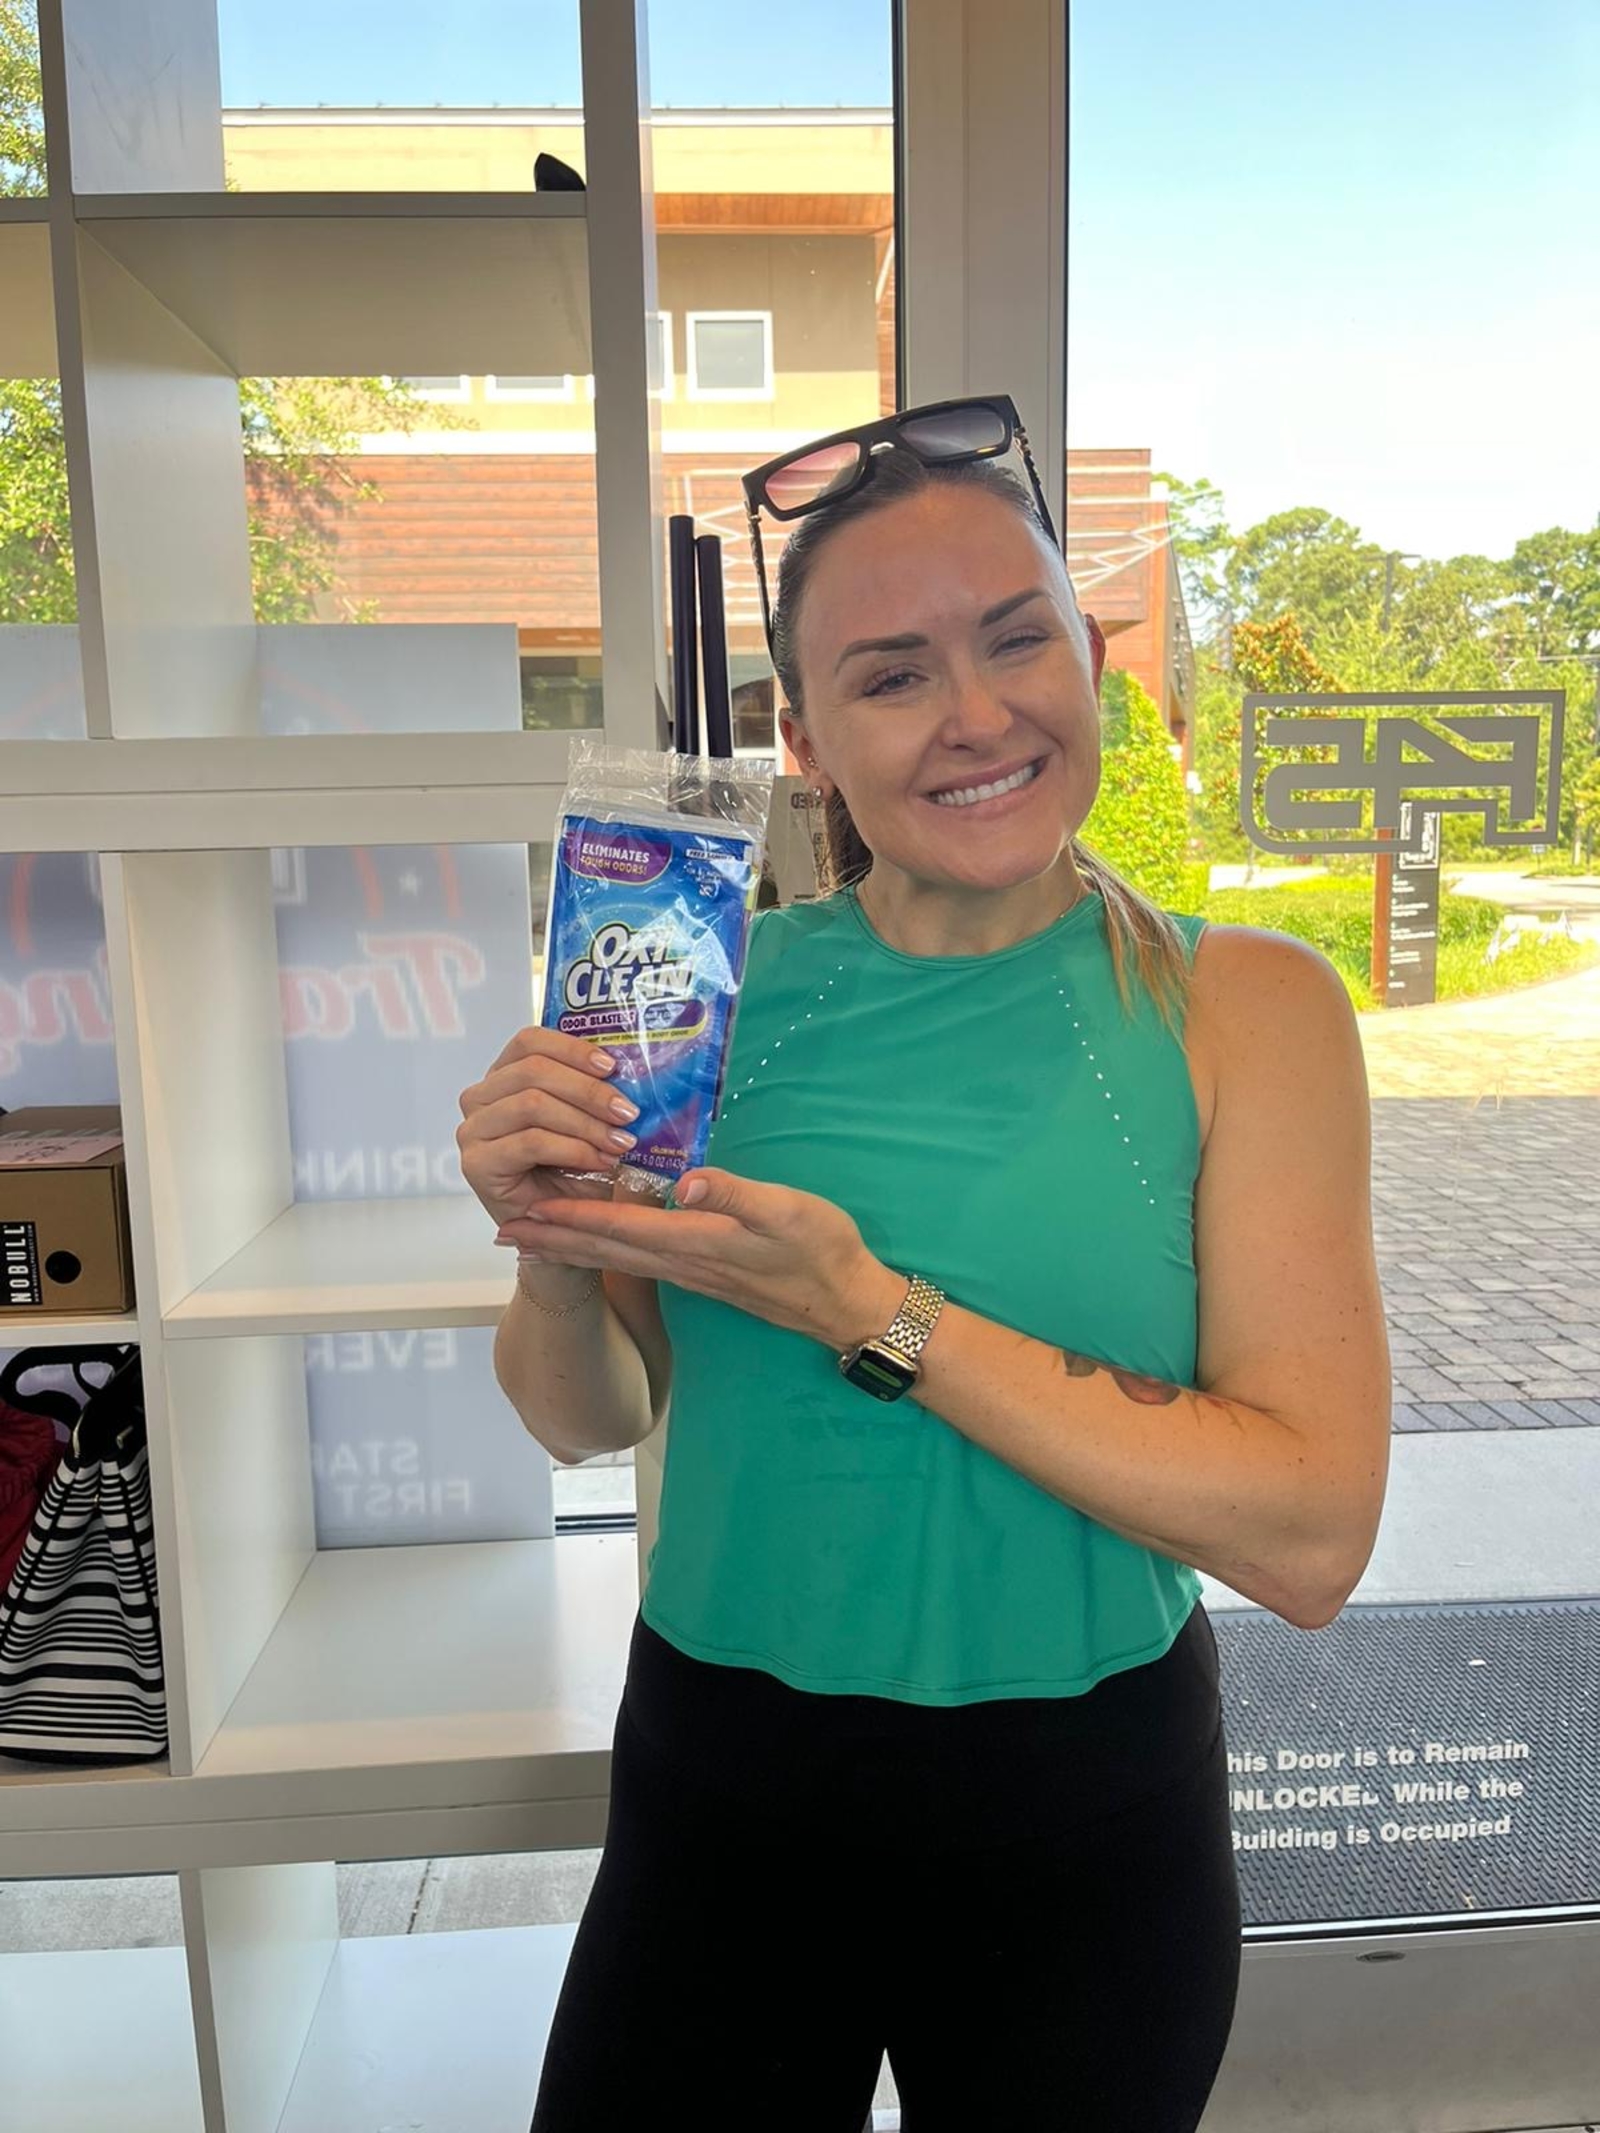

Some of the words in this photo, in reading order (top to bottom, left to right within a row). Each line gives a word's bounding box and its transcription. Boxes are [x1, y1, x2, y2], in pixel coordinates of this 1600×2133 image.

[580, 856, 610, 869] TOUGH
[612, 861, 648, 876] ODORS!
[582, 843, 650, 864] ELIMINATES
[591, 923, 668, 968] OXI
[565, 958, 692, 1010] CLEAN
[562, 1017, 588, 1030] ODOR
[4, 1225, 32, 1302] NOBULL
[1227, 1751, 1268, 1773] his
[1278, 1749, 1346, 1771] Door
[1354, 1746, 1379, 1767] is
[1387, 1746, 1416, 1765] to
[1425, 1740, 1530, 1763] Remain
[1229, 1783, 1380, 1812] NLOCKE
[1393, 1780, 1470, 1803] While
[1479, 1776, 1524, 1799] the
[1231, 1827, 1338, 1850] Building
[1346, 1824, 1371, 1845] is
[1380, 1814, 1512, 1843] Occupied
